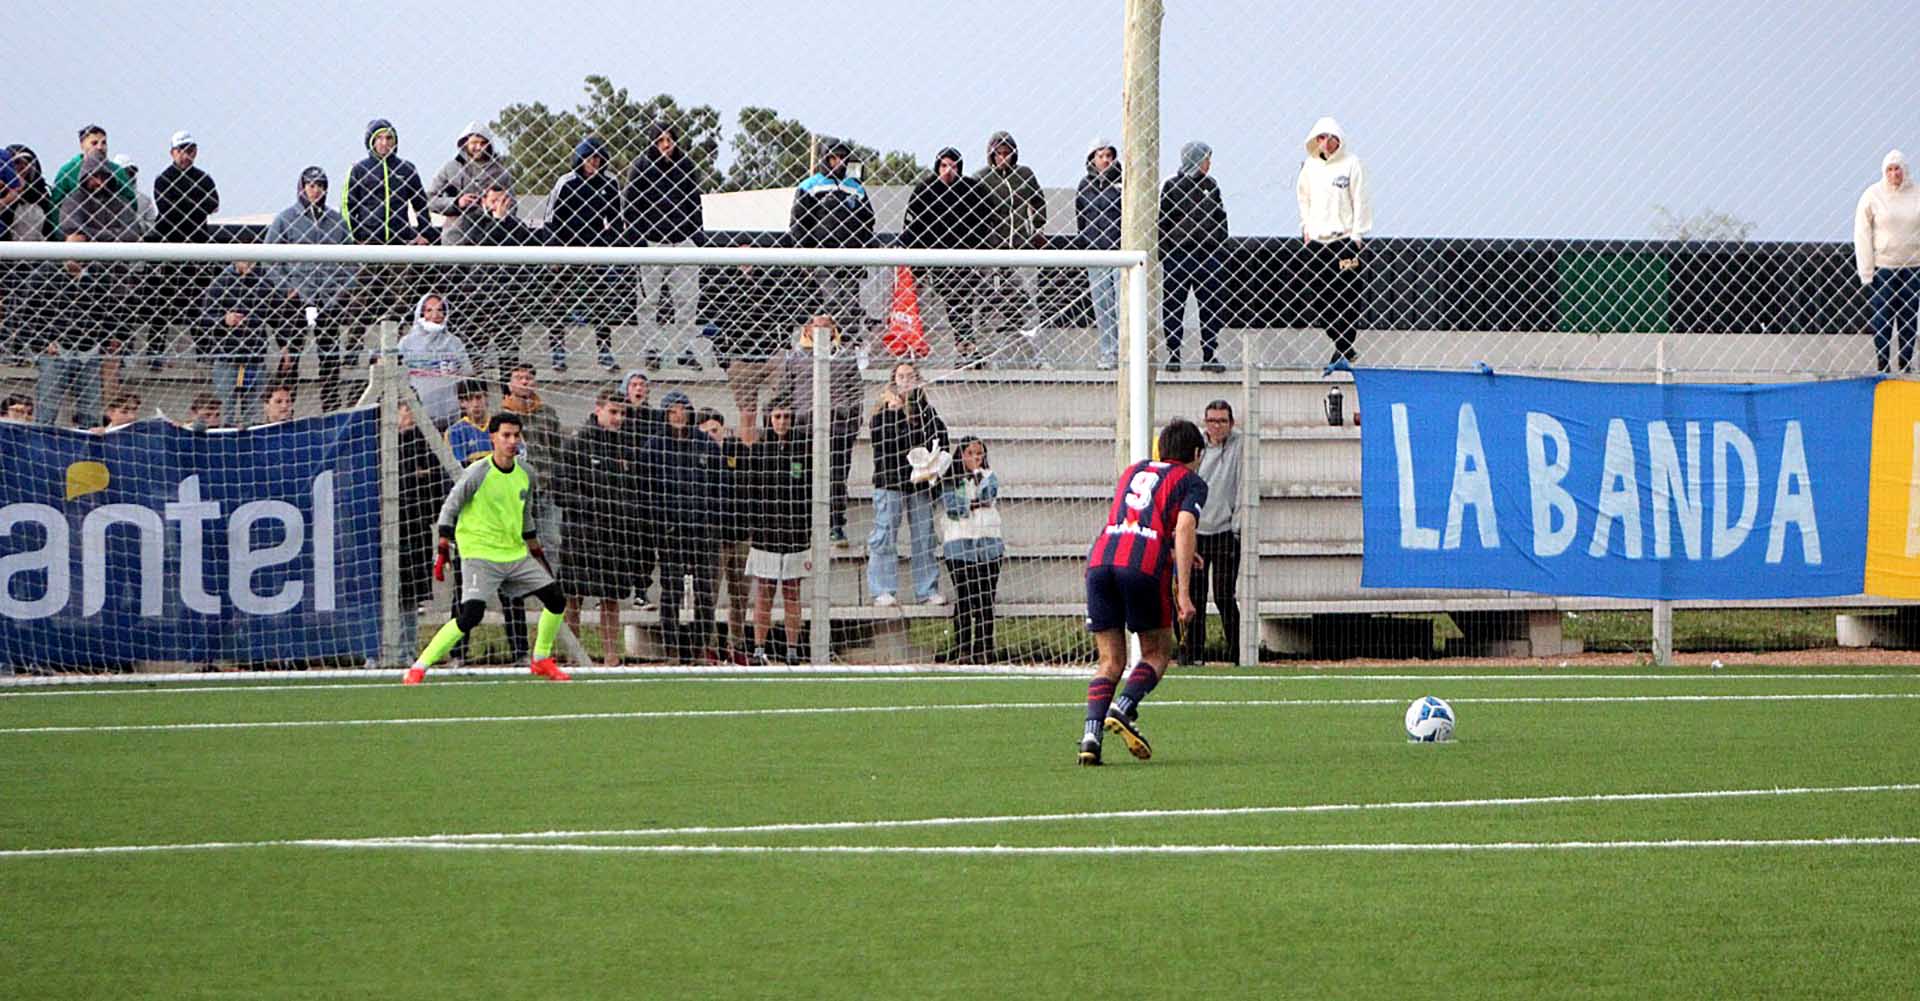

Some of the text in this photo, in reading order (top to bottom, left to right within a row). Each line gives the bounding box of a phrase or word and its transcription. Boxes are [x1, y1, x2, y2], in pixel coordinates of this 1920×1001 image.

[0, 469, 336, 620] antel
[1125, 471, 1160, 511] 9
[1391, 402, 1500, 550] LA
[1526, 410, 1823, 565] BANDA
